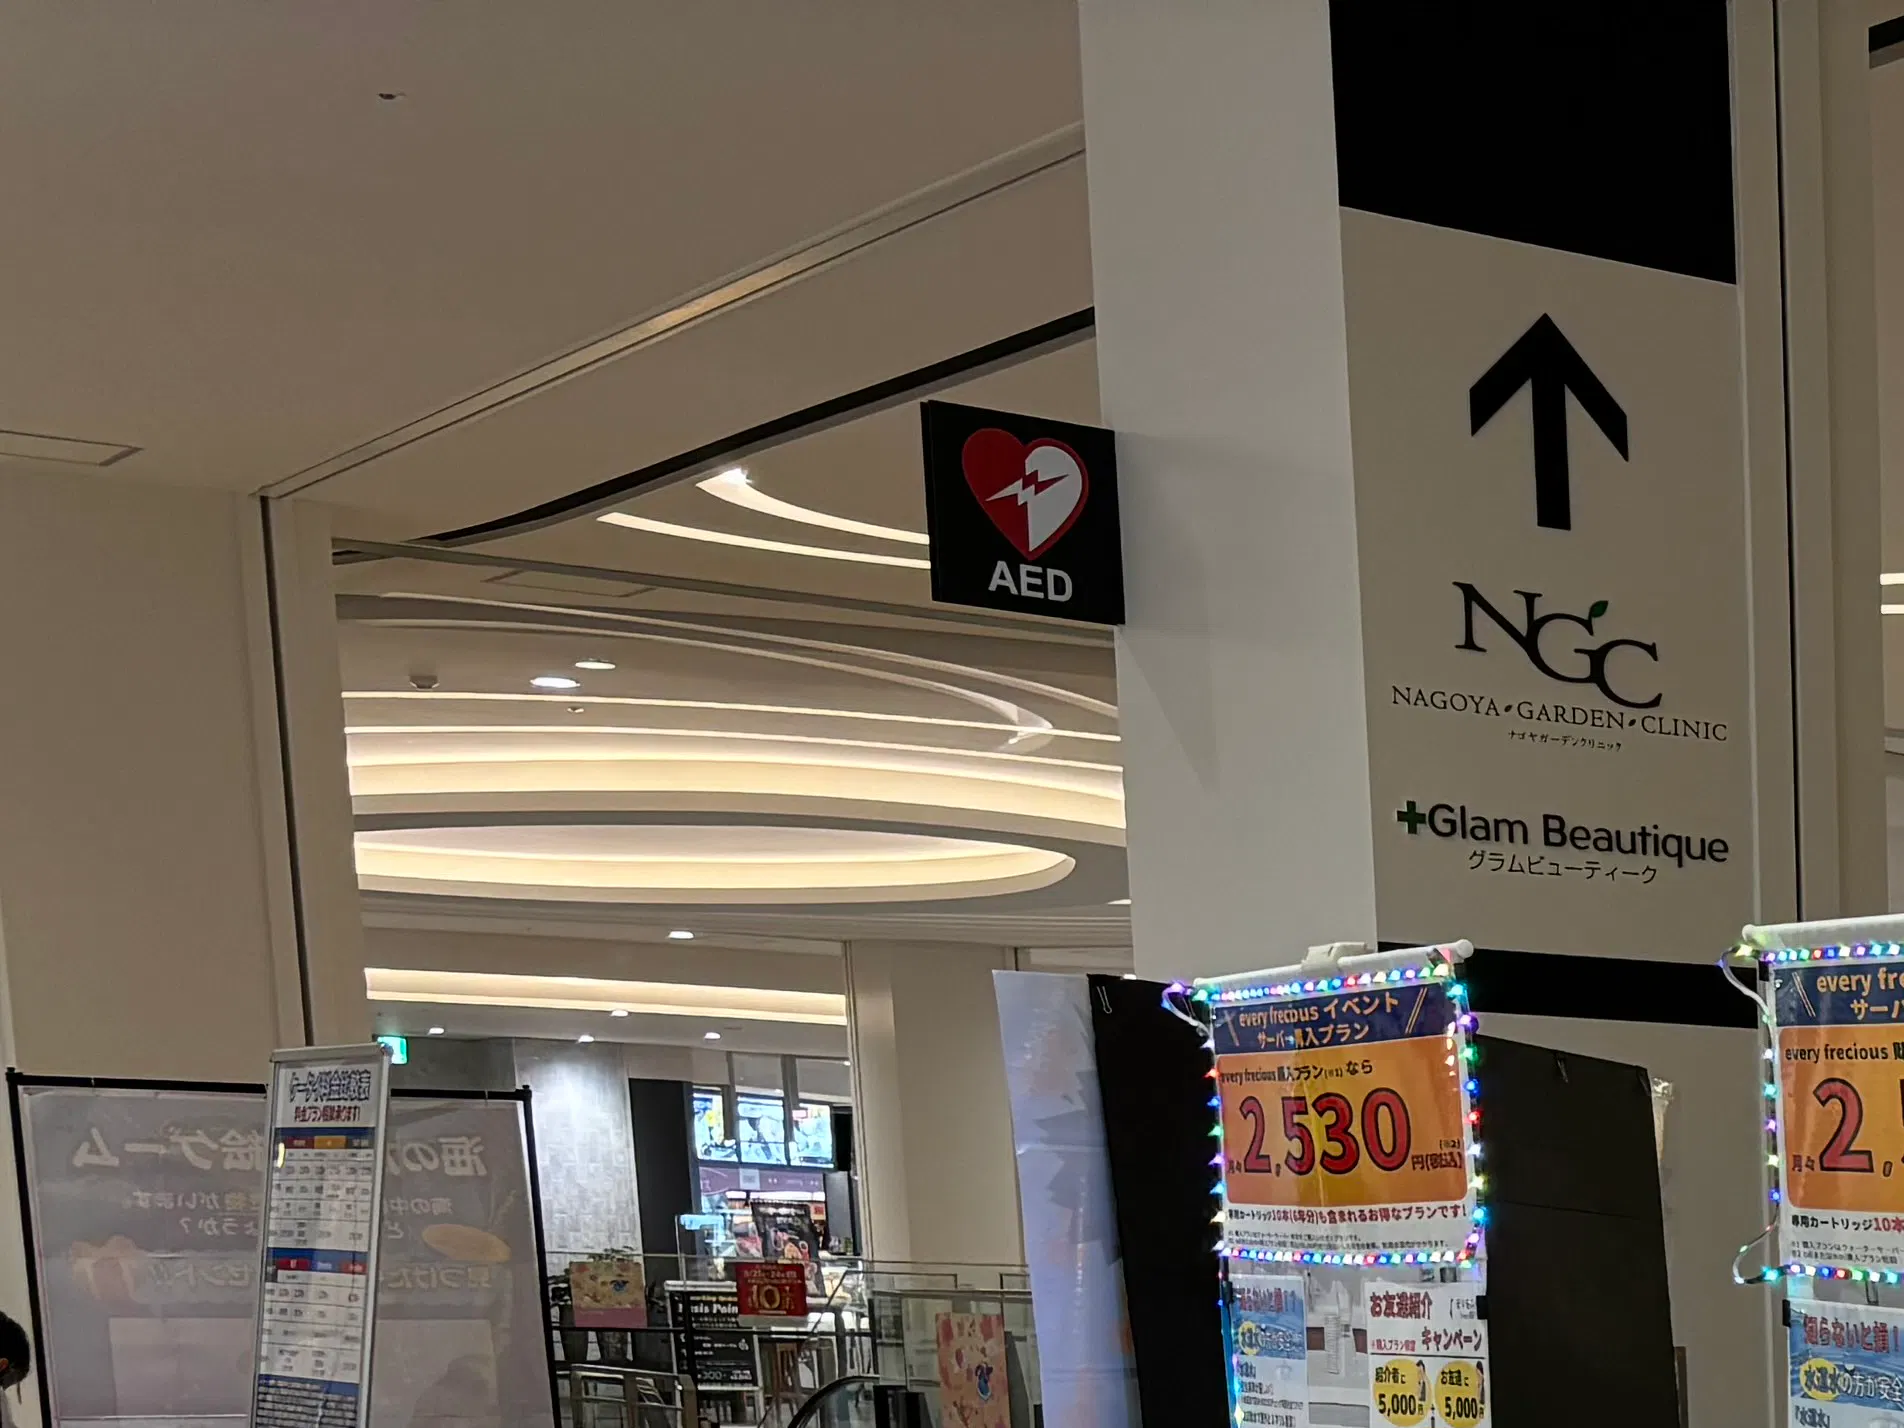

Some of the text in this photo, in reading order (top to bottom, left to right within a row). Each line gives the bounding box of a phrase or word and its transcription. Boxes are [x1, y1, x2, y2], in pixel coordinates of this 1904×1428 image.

[988, 560, 1073, 603] AED
[1452, 579, 1664, 709] NGC
[1507, 729, 1623, 753] ナゴヤガーデンクリニック
[1543, 813, 1730, 870] Beautique
[1468, 850, 1657, 886] グラムビューティーク
[1816, 967, 1872, 995] every
[1323, 991, 1399, 1020] イベント
[1784, 1044, 1820, 1064] every
[1823, 1041, 1889, 1062] frecious
[1422, 1326, 1482, 1352] キャンペーン
